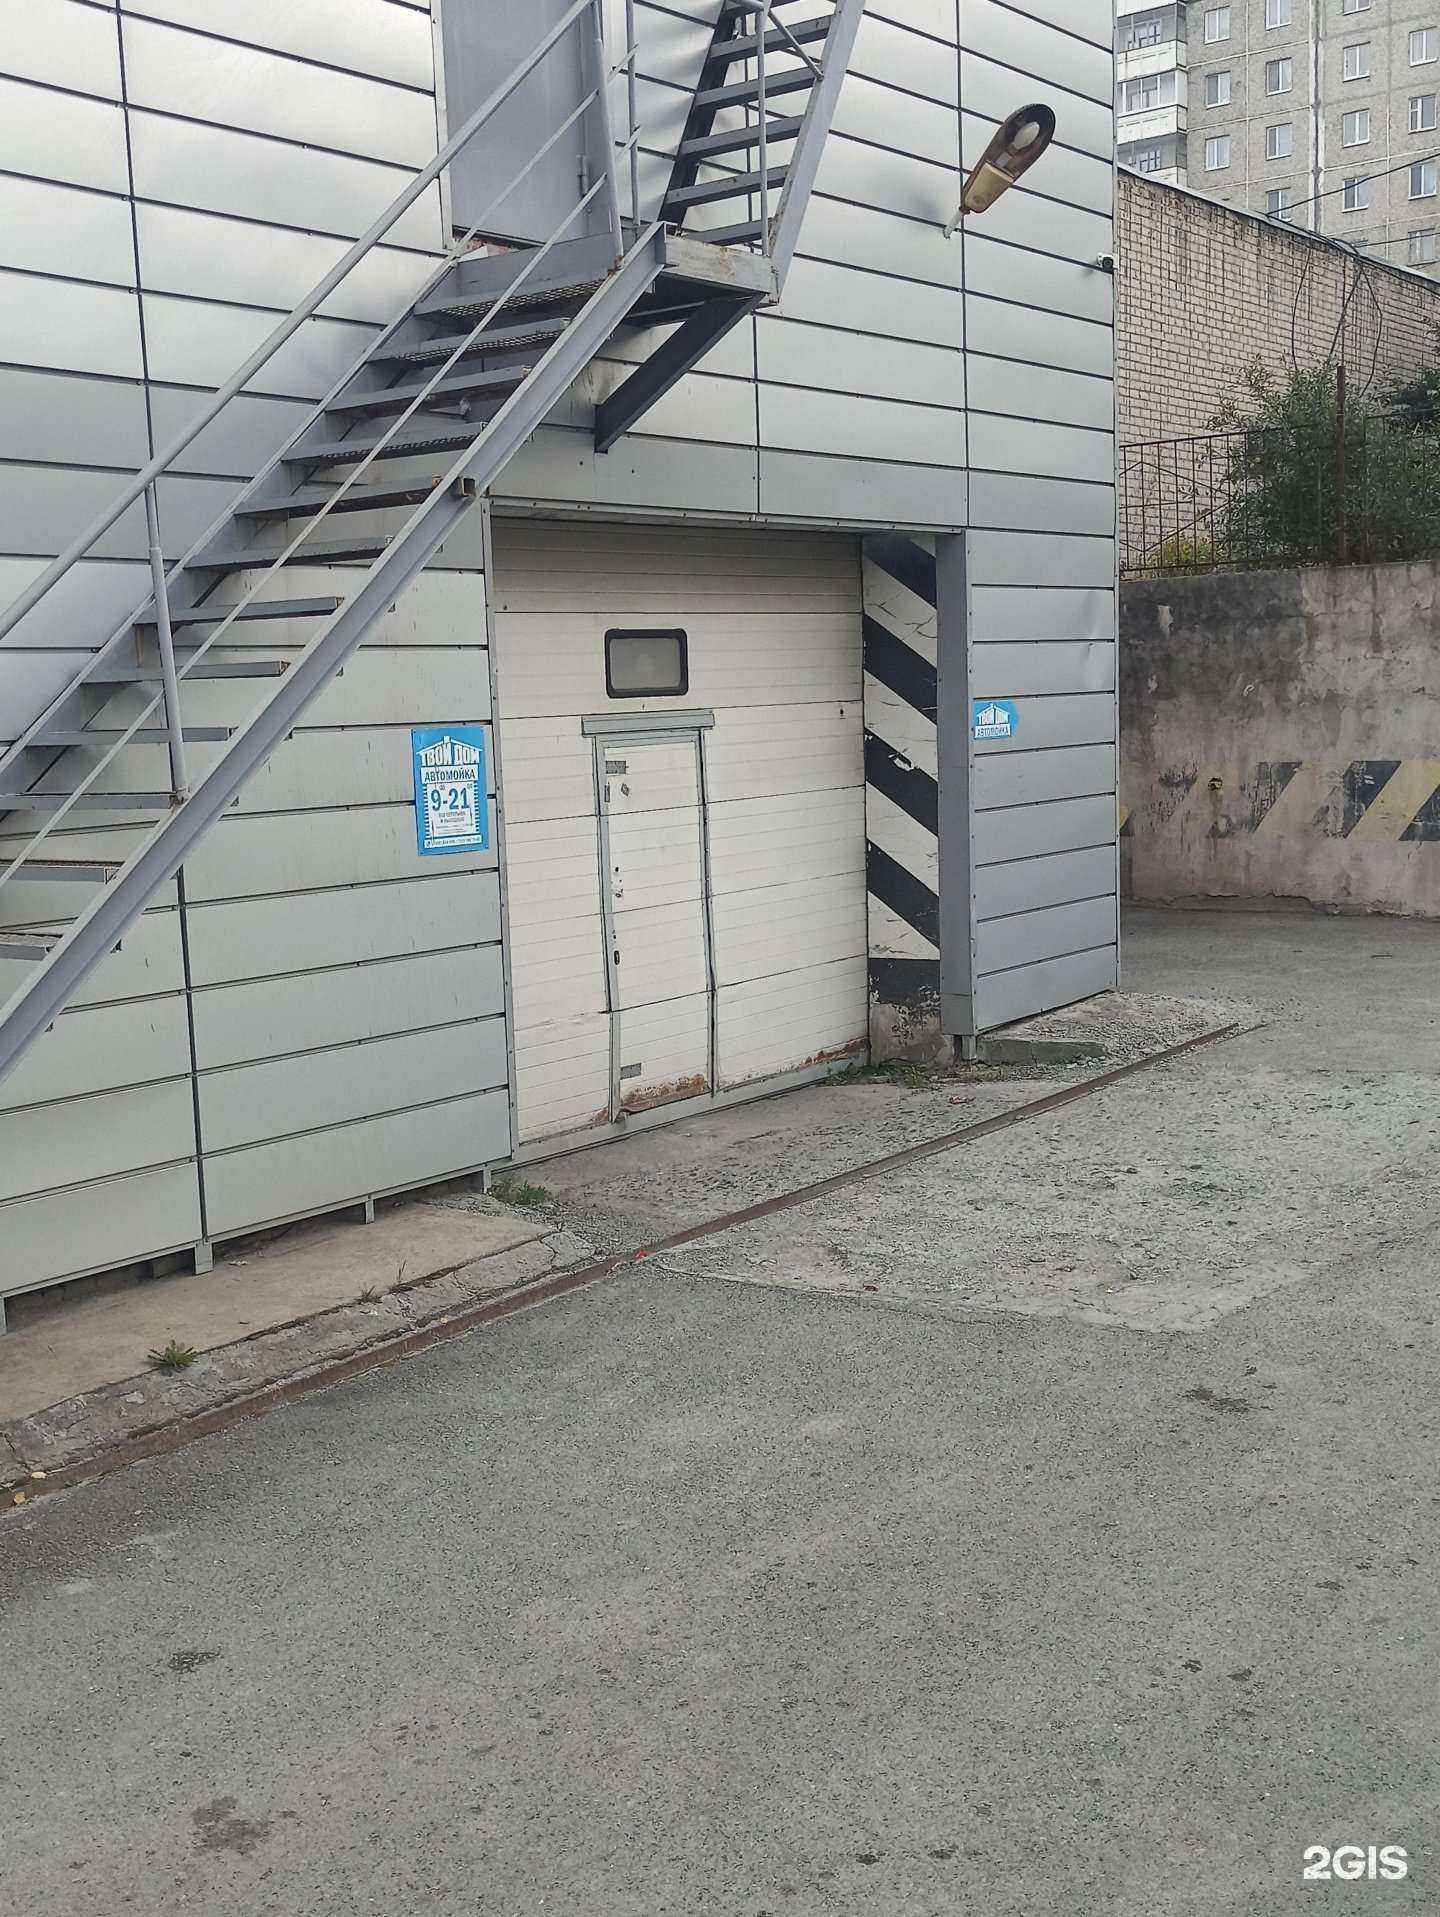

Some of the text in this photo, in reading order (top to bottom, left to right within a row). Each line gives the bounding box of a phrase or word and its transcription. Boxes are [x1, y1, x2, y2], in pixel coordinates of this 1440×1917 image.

[421, 742, 480, 766] ТВОЙ ДОМ
[424, 767, 476, 783] АВТОМОЙКА
